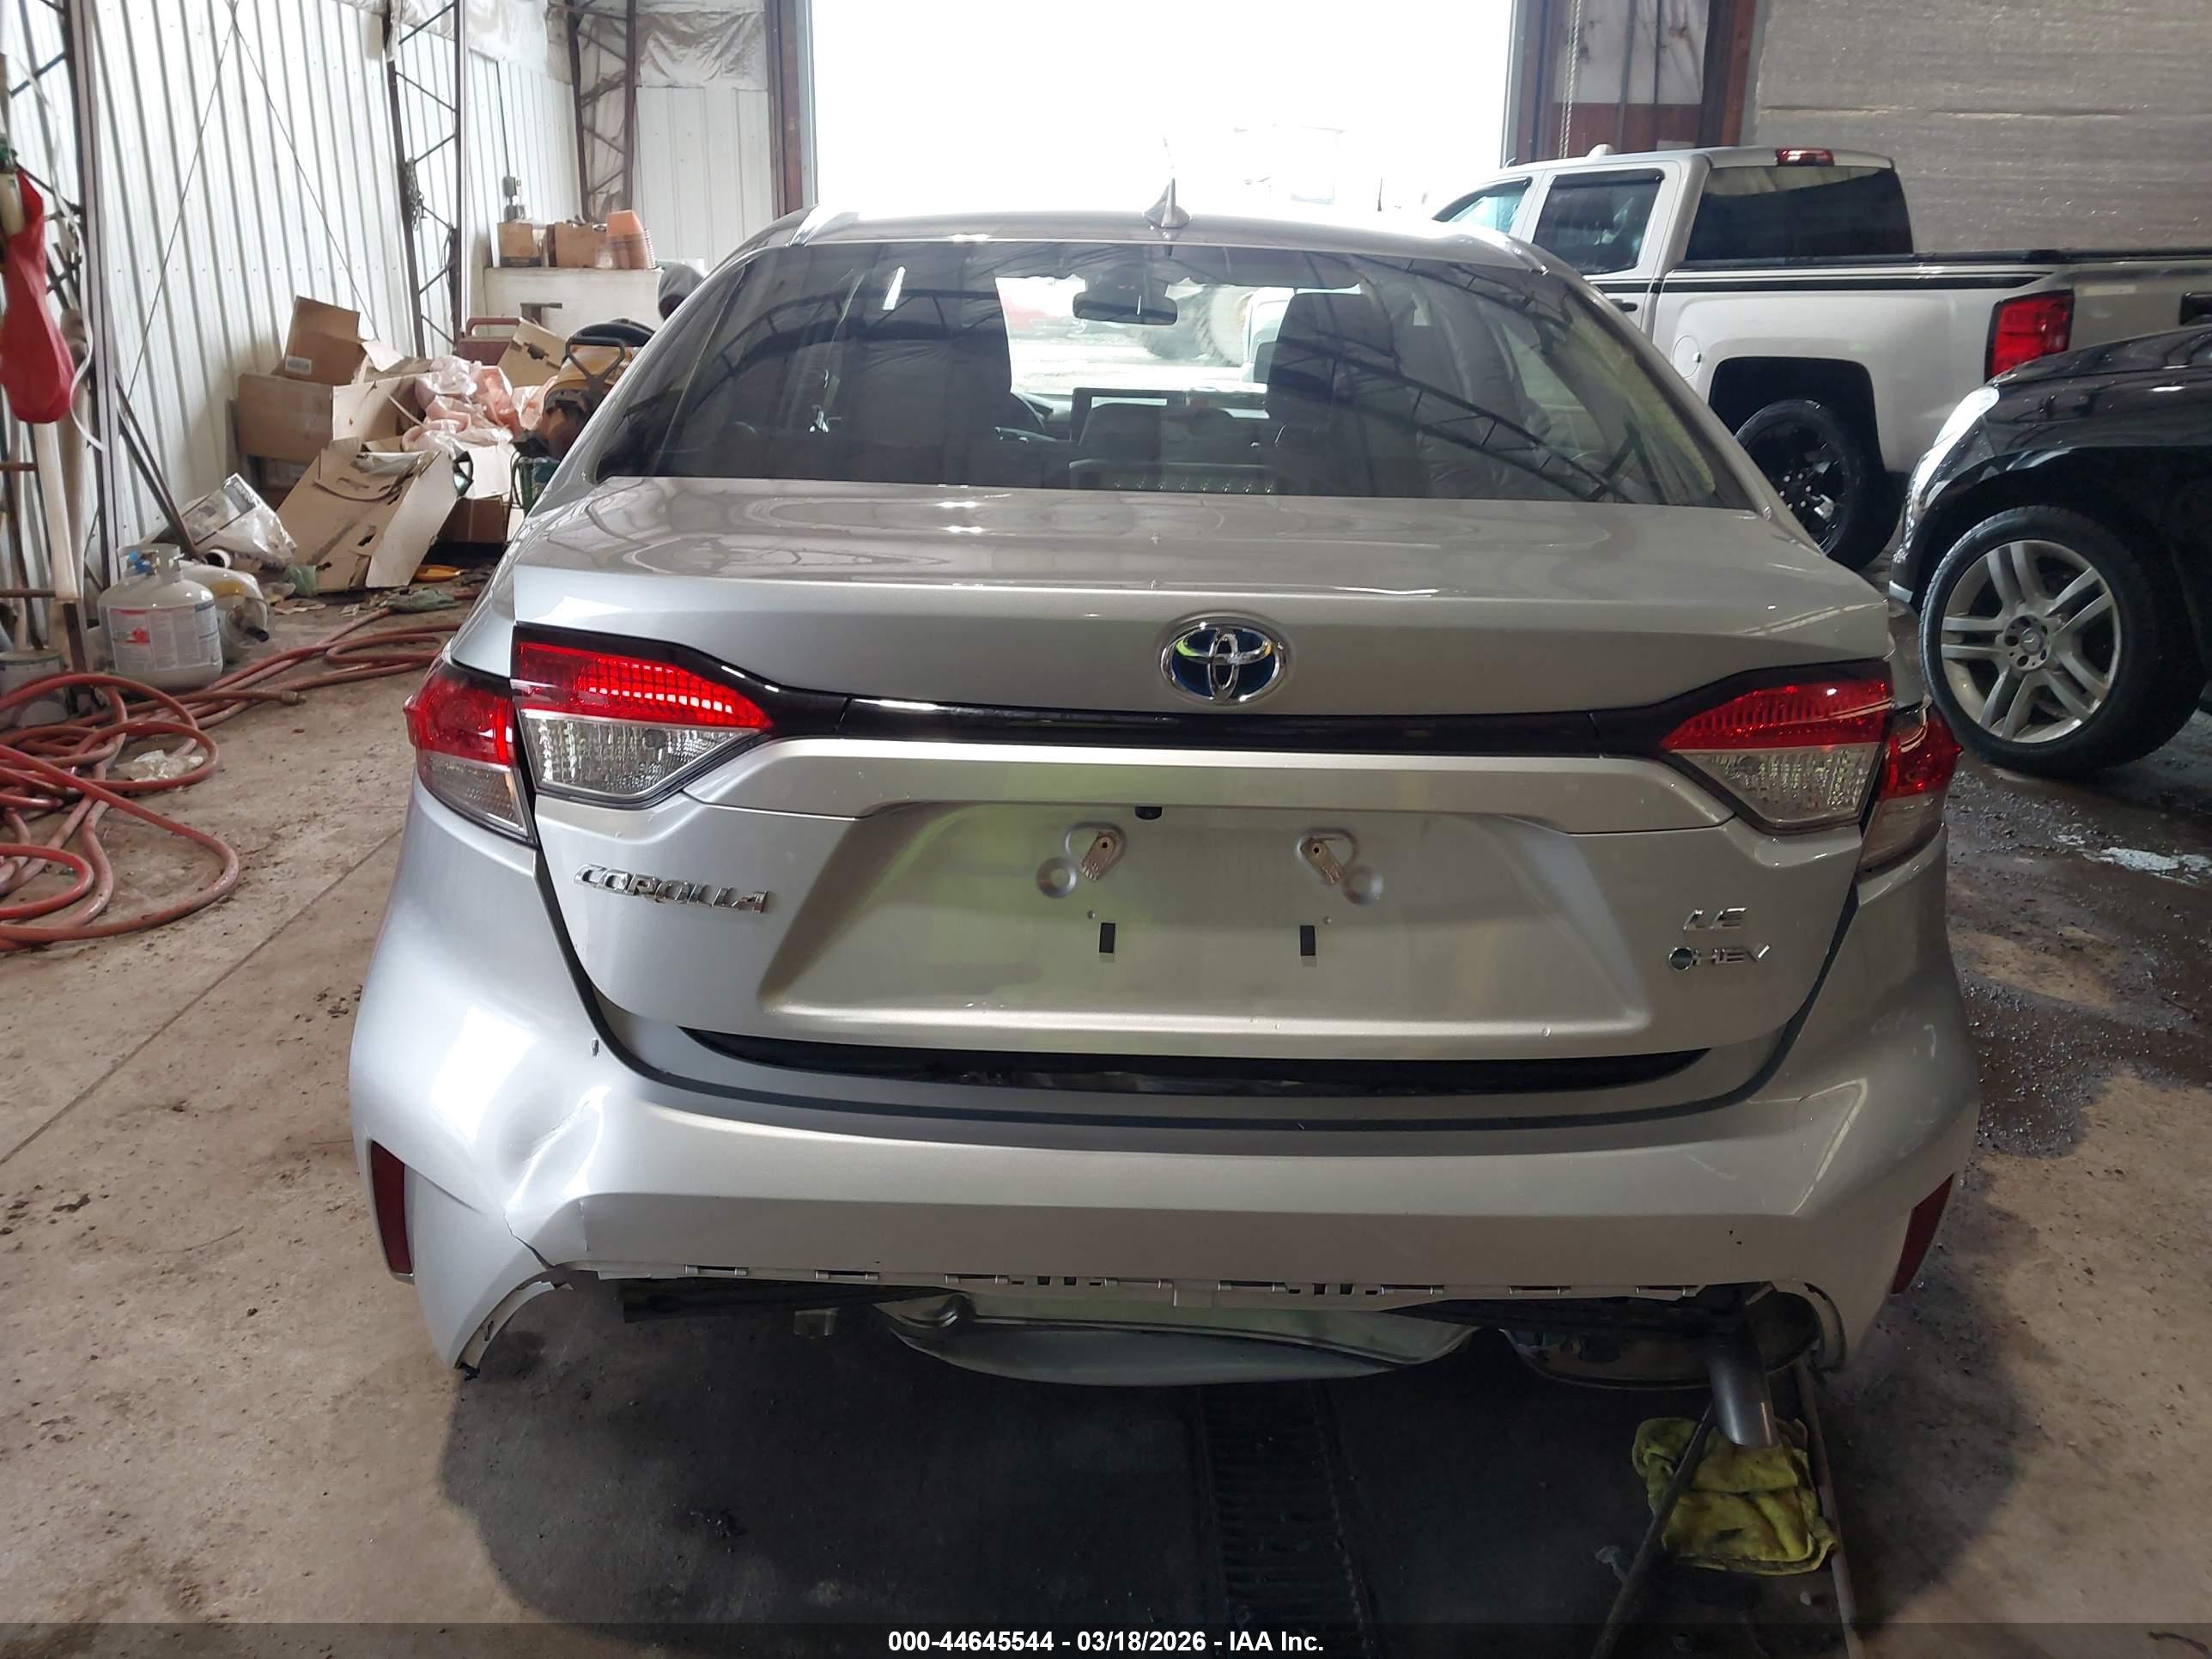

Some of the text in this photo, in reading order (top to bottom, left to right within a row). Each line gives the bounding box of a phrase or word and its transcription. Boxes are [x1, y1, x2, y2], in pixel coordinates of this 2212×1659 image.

[574, 864, 768, 914] COROLLA
[1683, 907, 1747, 930] LE
[1692, 944, 1770, 964] HEV
